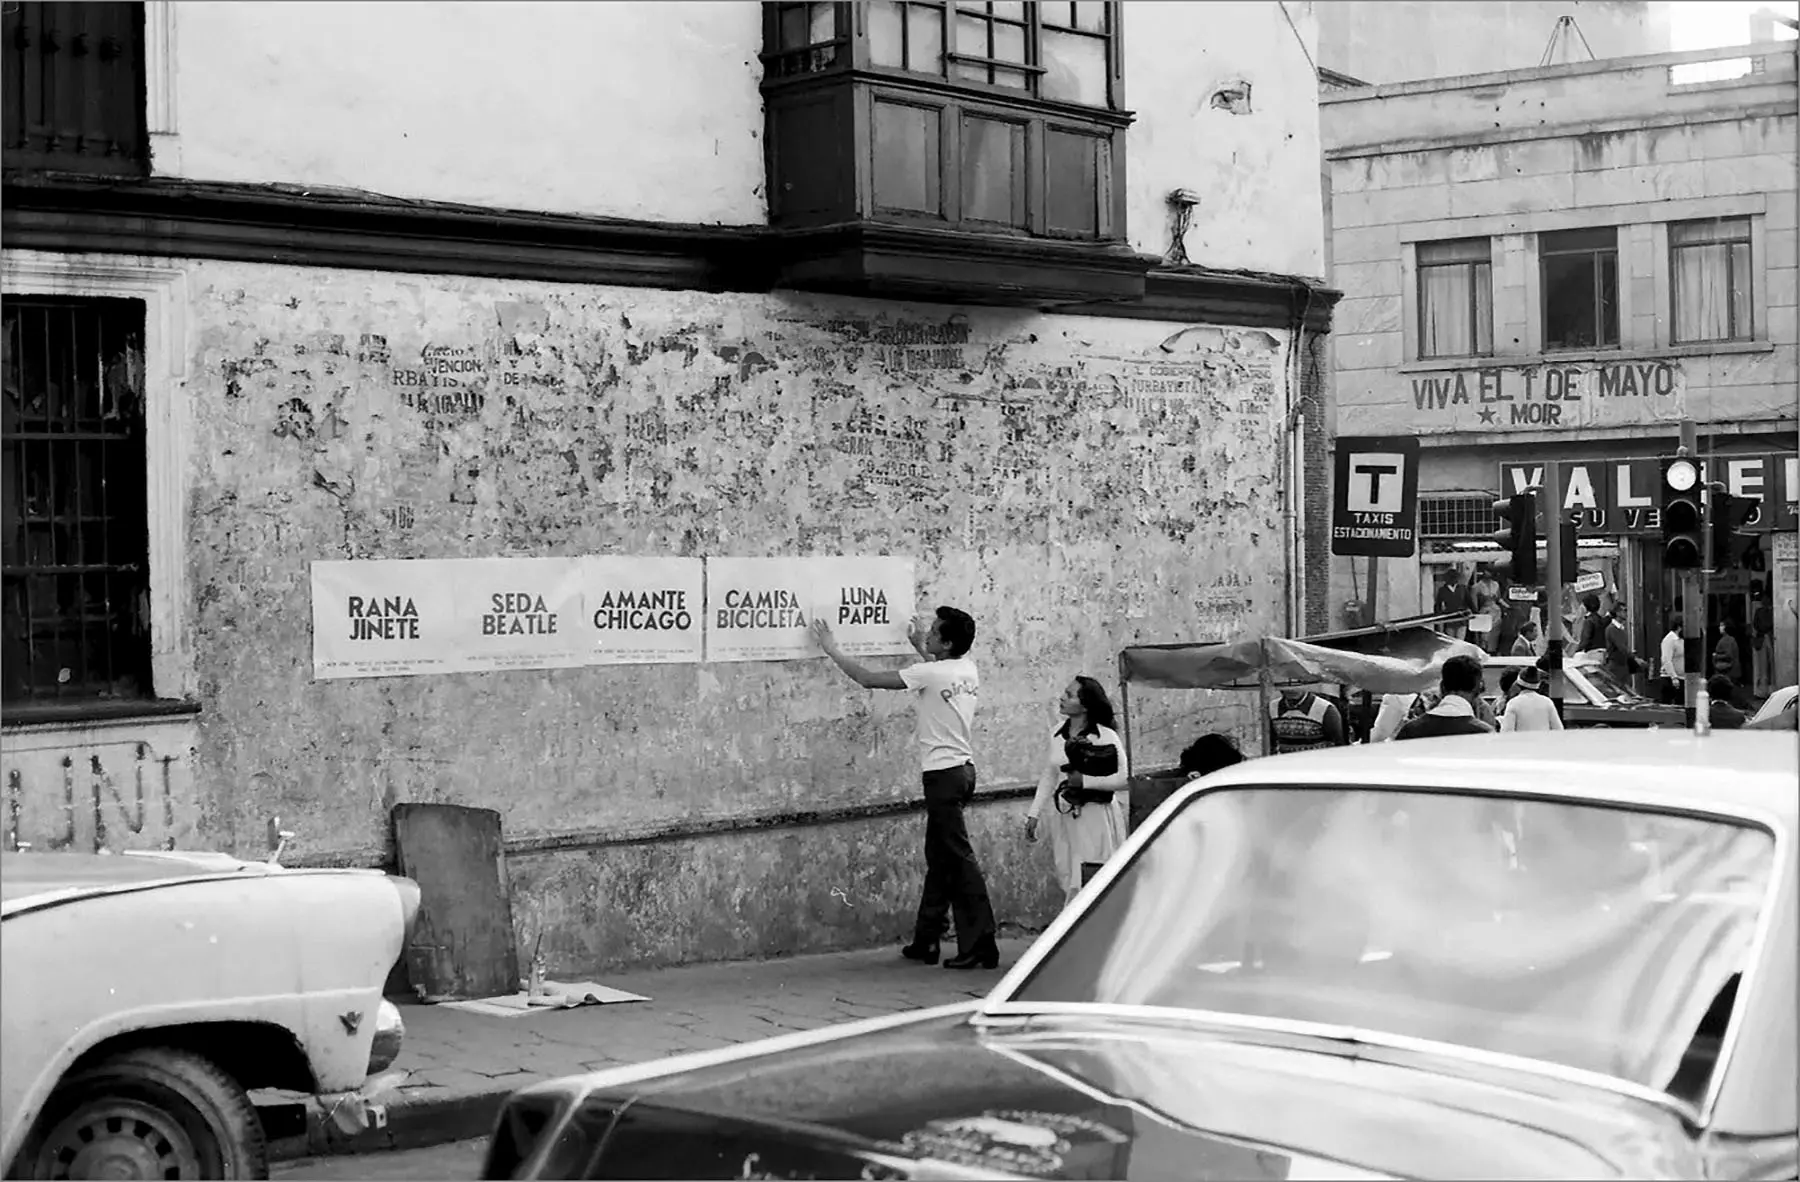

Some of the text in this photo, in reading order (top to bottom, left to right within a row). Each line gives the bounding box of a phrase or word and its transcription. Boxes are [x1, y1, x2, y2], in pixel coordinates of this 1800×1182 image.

[1412, 373, 1469, 410] VIVA
[1479, 371, 1514, 401] EL
[1546, 368, 1582, 400] DE
[1600, 364, 1674, 397] MAYO
[1511, 403, 1562, 425] MOIR
[1355, 465, 1397, 504] T
[1354, 513, 1394, 525] TAXIS
[1334, 527, 1412, 541] ESTACIONAMIENTO
[348, 596, 419, 618] RANA
[491, 593, 548, 613] SEDA
[600, 590, 687, 610] AMANTE
[725, 589, 800, 610] CAMISA
[841, 587, 888, 606] LUNA
[482, 614, 558, 635] BEATLE
[593, 609, 692, 631] CHICAGO
[716, 608, 808, 629] BICICLETA
[838, 606, 890, 625] PAPEL
[349, 618, 420, 640] JINETE
